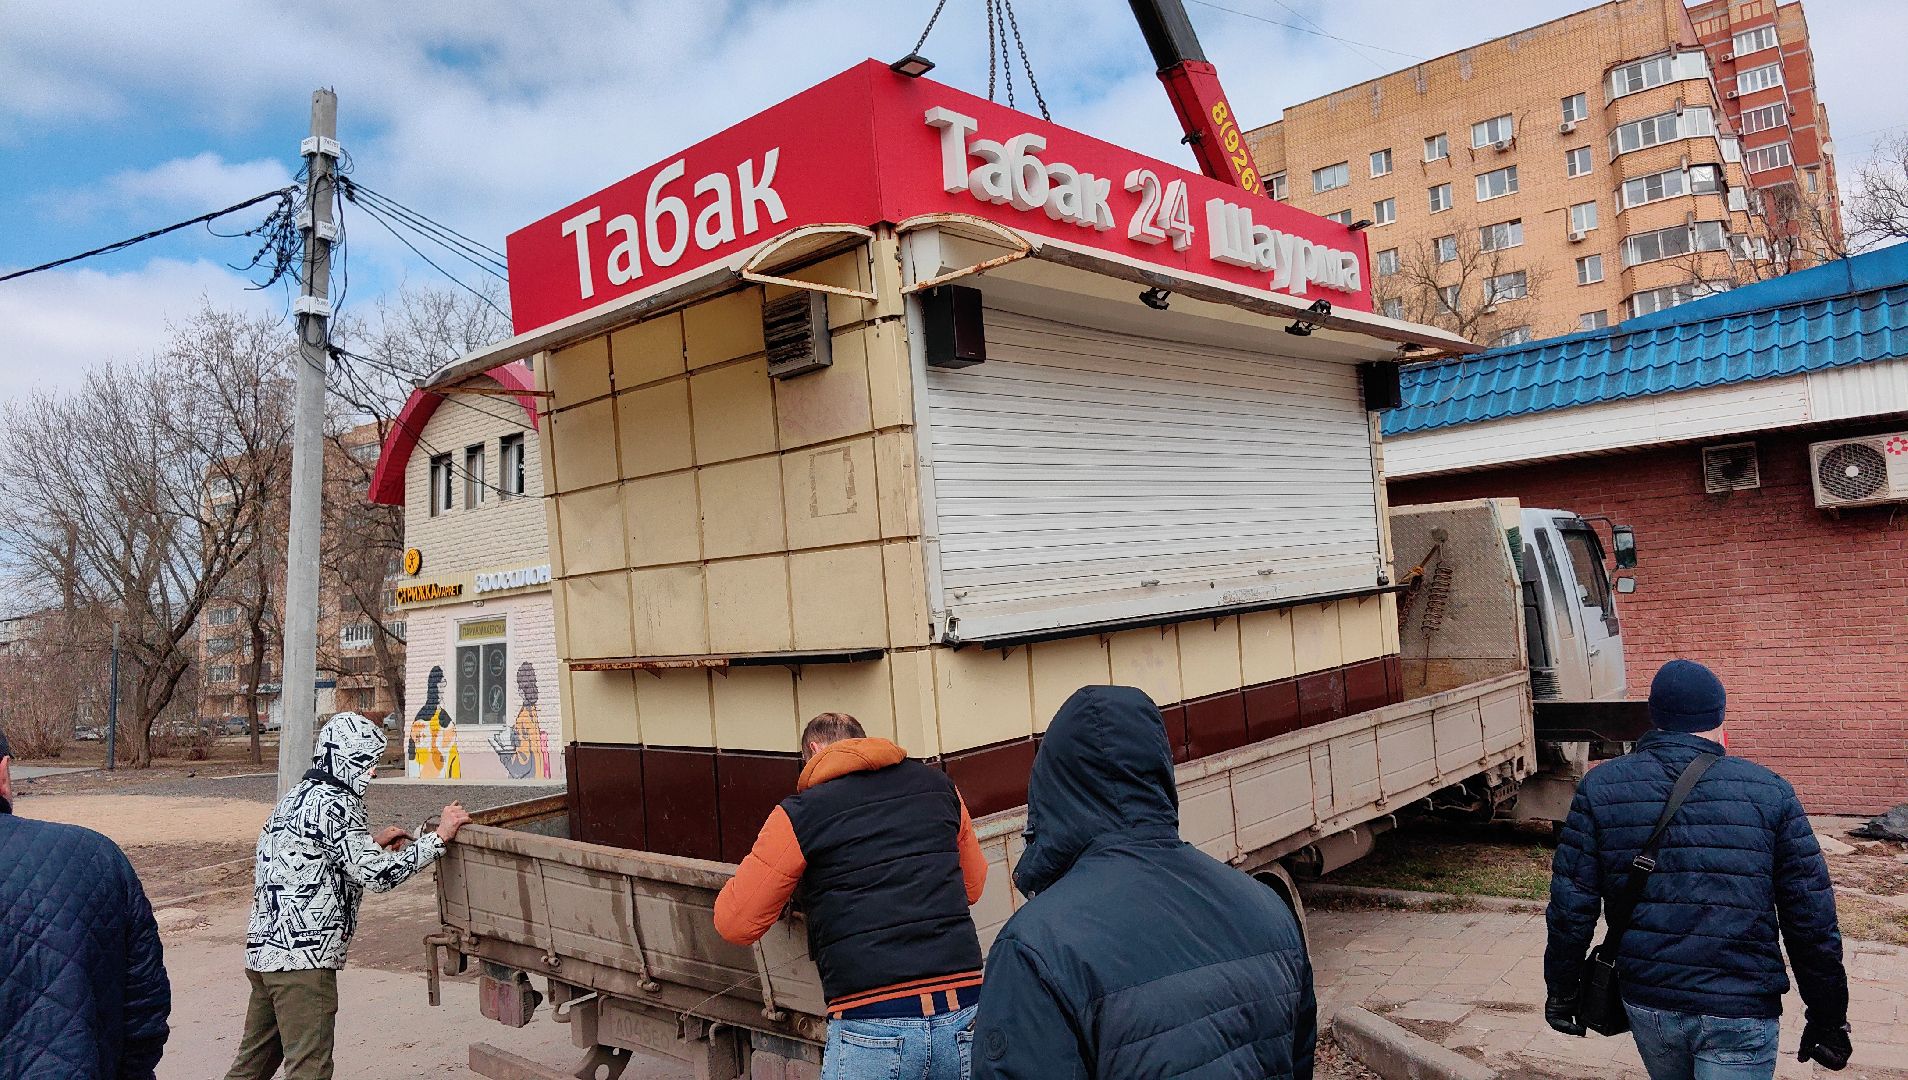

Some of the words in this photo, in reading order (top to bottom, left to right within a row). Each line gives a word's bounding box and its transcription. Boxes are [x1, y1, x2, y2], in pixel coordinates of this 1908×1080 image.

[562, 147, 788, 299] Табак
[924, 106, 1115, 231] Табак
[1124, 168, 1195, 251] 24
[1205, 198, 1362, 295] Шаурма
